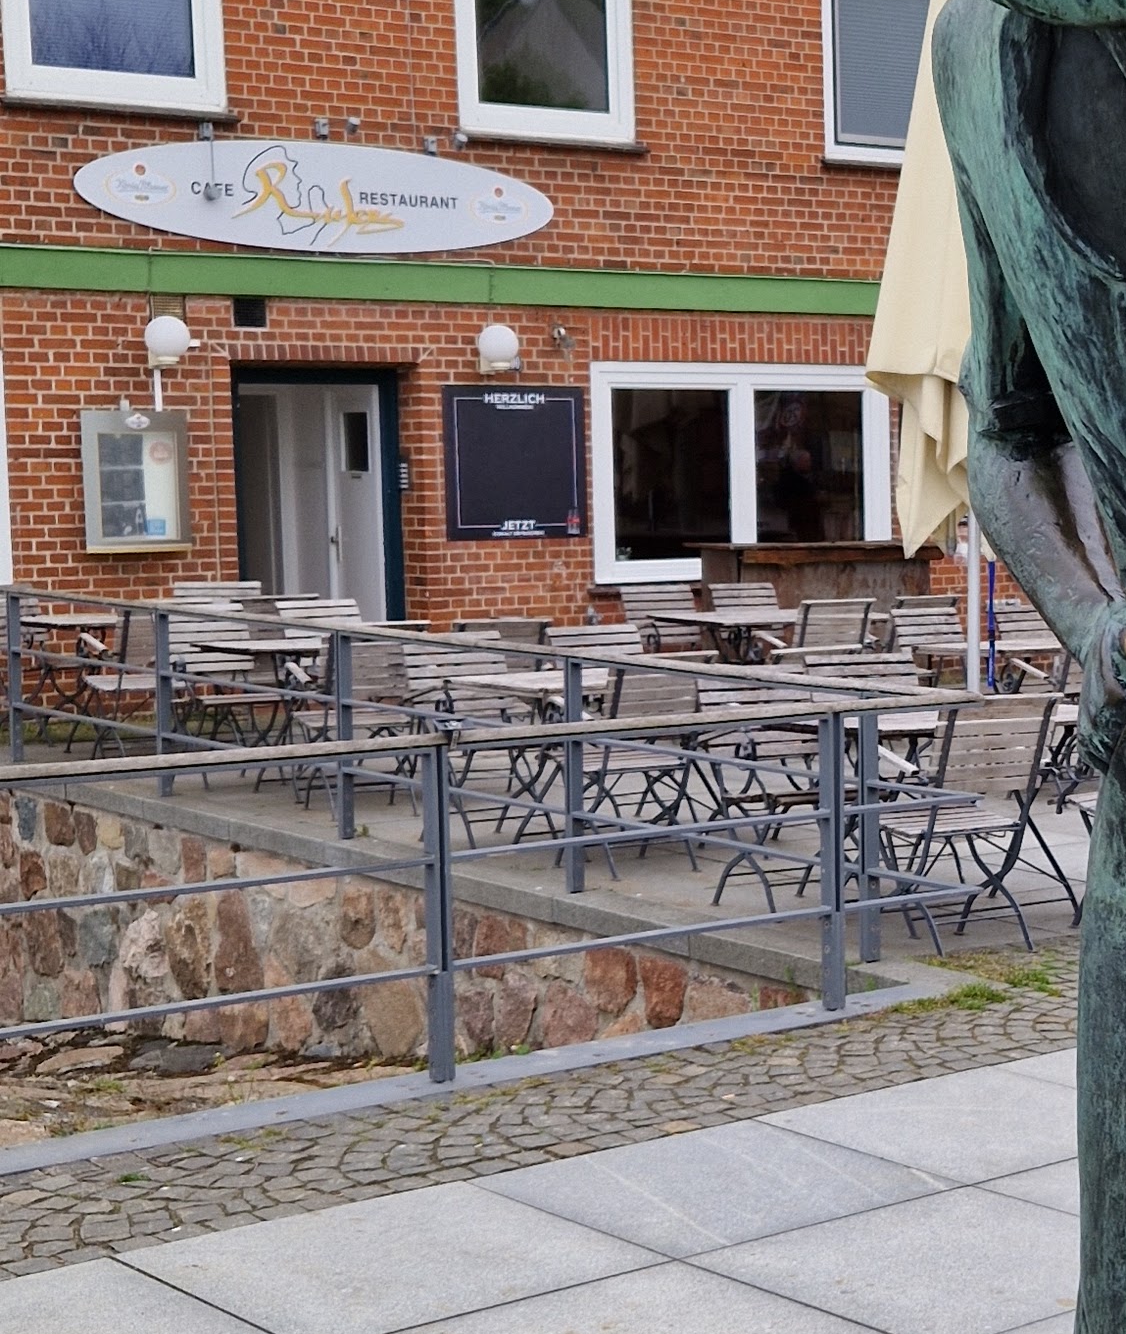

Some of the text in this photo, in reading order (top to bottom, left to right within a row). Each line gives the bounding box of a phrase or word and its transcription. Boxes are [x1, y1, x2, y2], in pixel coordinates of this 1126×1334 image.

[359, 191, 459, 209] RESTAURANT
[484, 392, 545, 405] HERZLICH
[500, 519, 537, 531] JETZT
